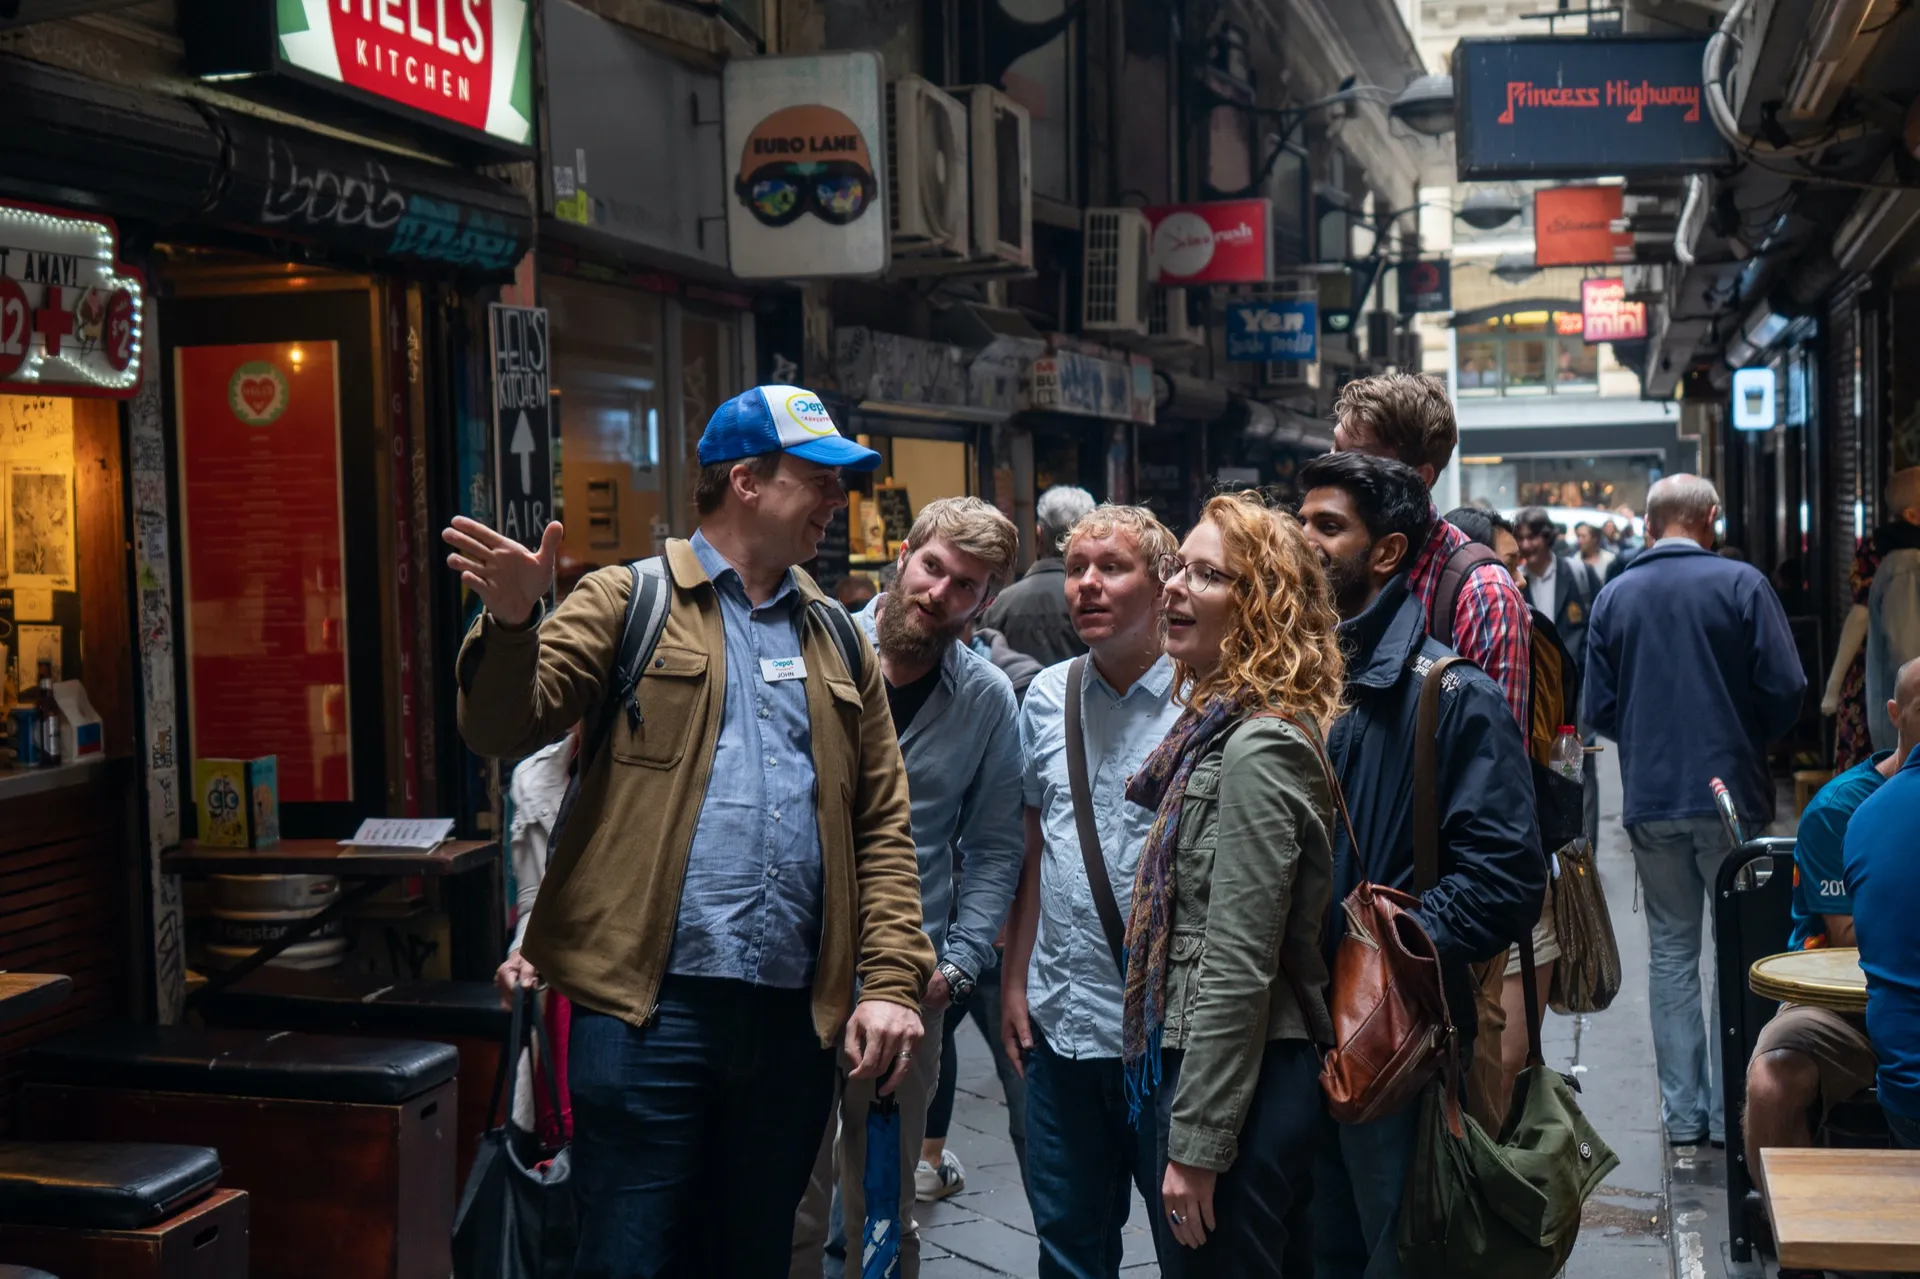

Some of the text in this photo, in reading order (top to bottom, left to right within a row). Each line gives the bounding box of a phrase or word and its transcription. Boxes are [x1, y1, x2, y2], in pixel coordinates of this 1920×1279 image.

[356, 37, 470, 102] KITCHEN
[1497, 79, 1700, 124] Princess Highway
[754, 135, 857, 154] EURO LANE
[24, 251, 77, 287] AWAY!
[1238, 309, 1304, 332] Yen
[498, 372, 546, 409] KITCHEN
